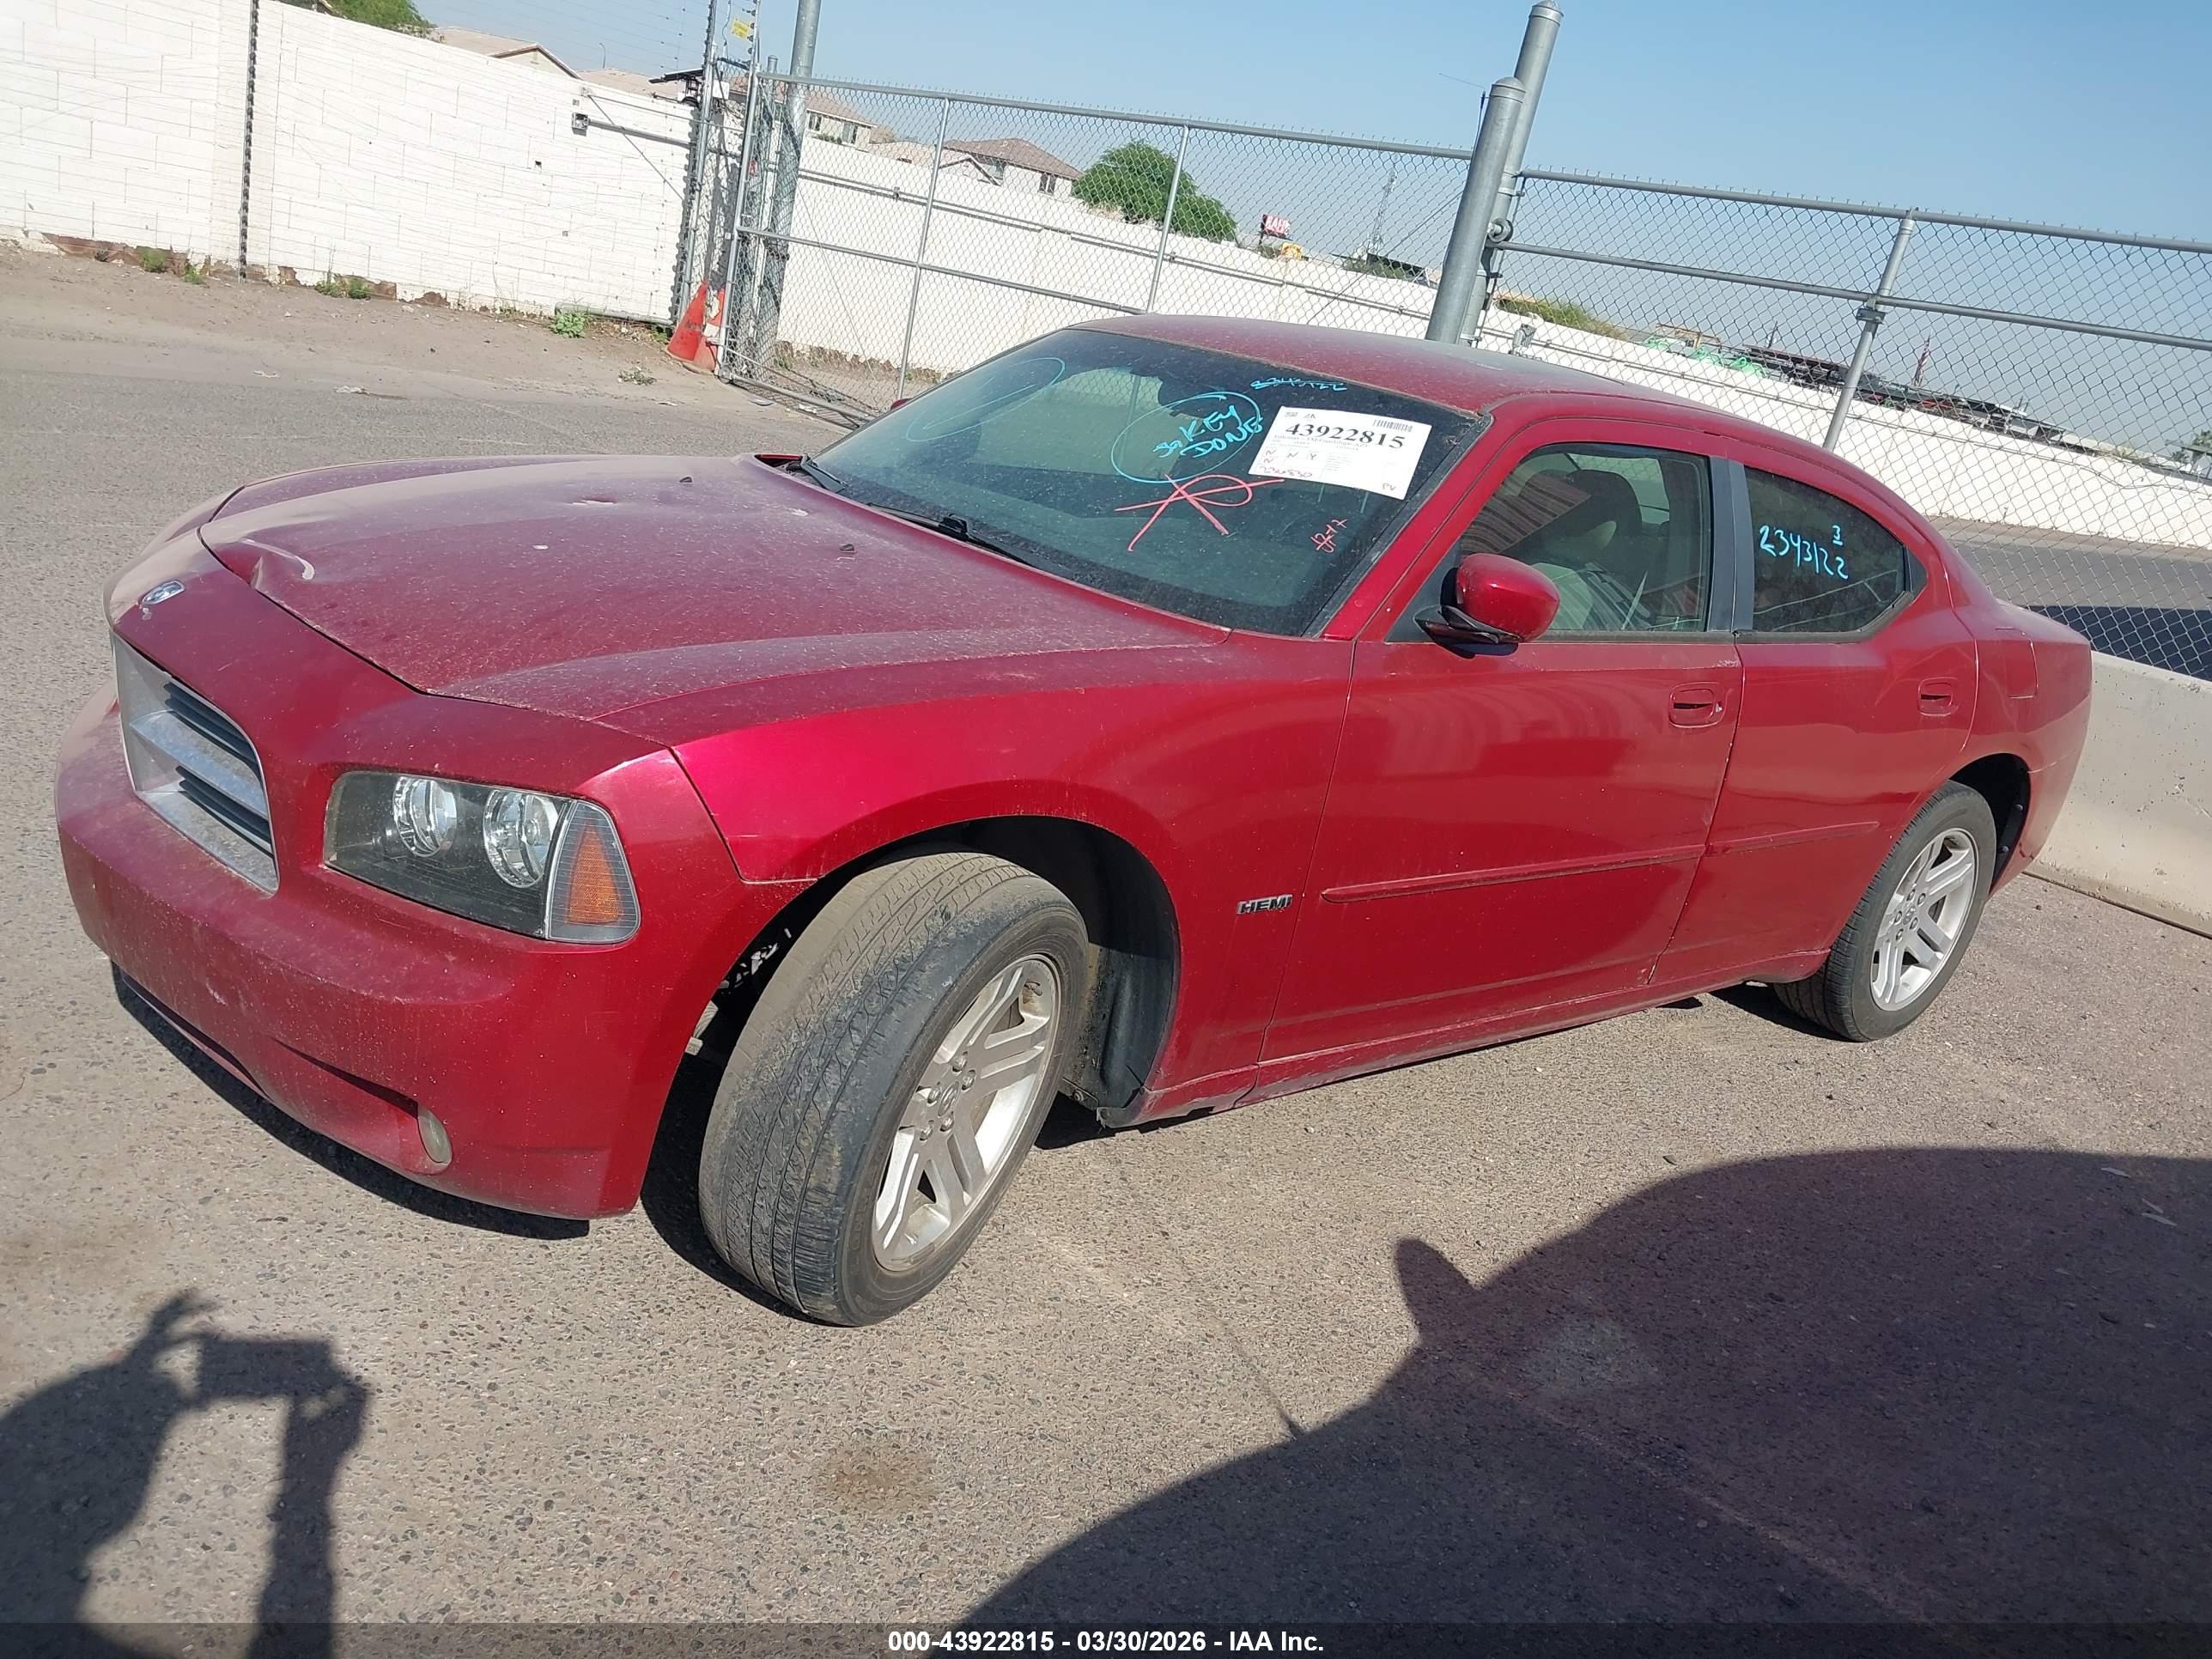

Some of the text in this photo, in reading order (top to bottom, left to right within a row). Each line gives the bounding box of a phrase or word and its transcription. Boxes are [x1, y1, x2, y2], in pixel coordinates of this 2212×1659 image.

[1180, 416, 1263, 459] DONE
[1285, 423, 1406, 449] 43922815
[1759, 525, 1849, 580] 2343122
[1237, 893, 1293, 915] HEMI
